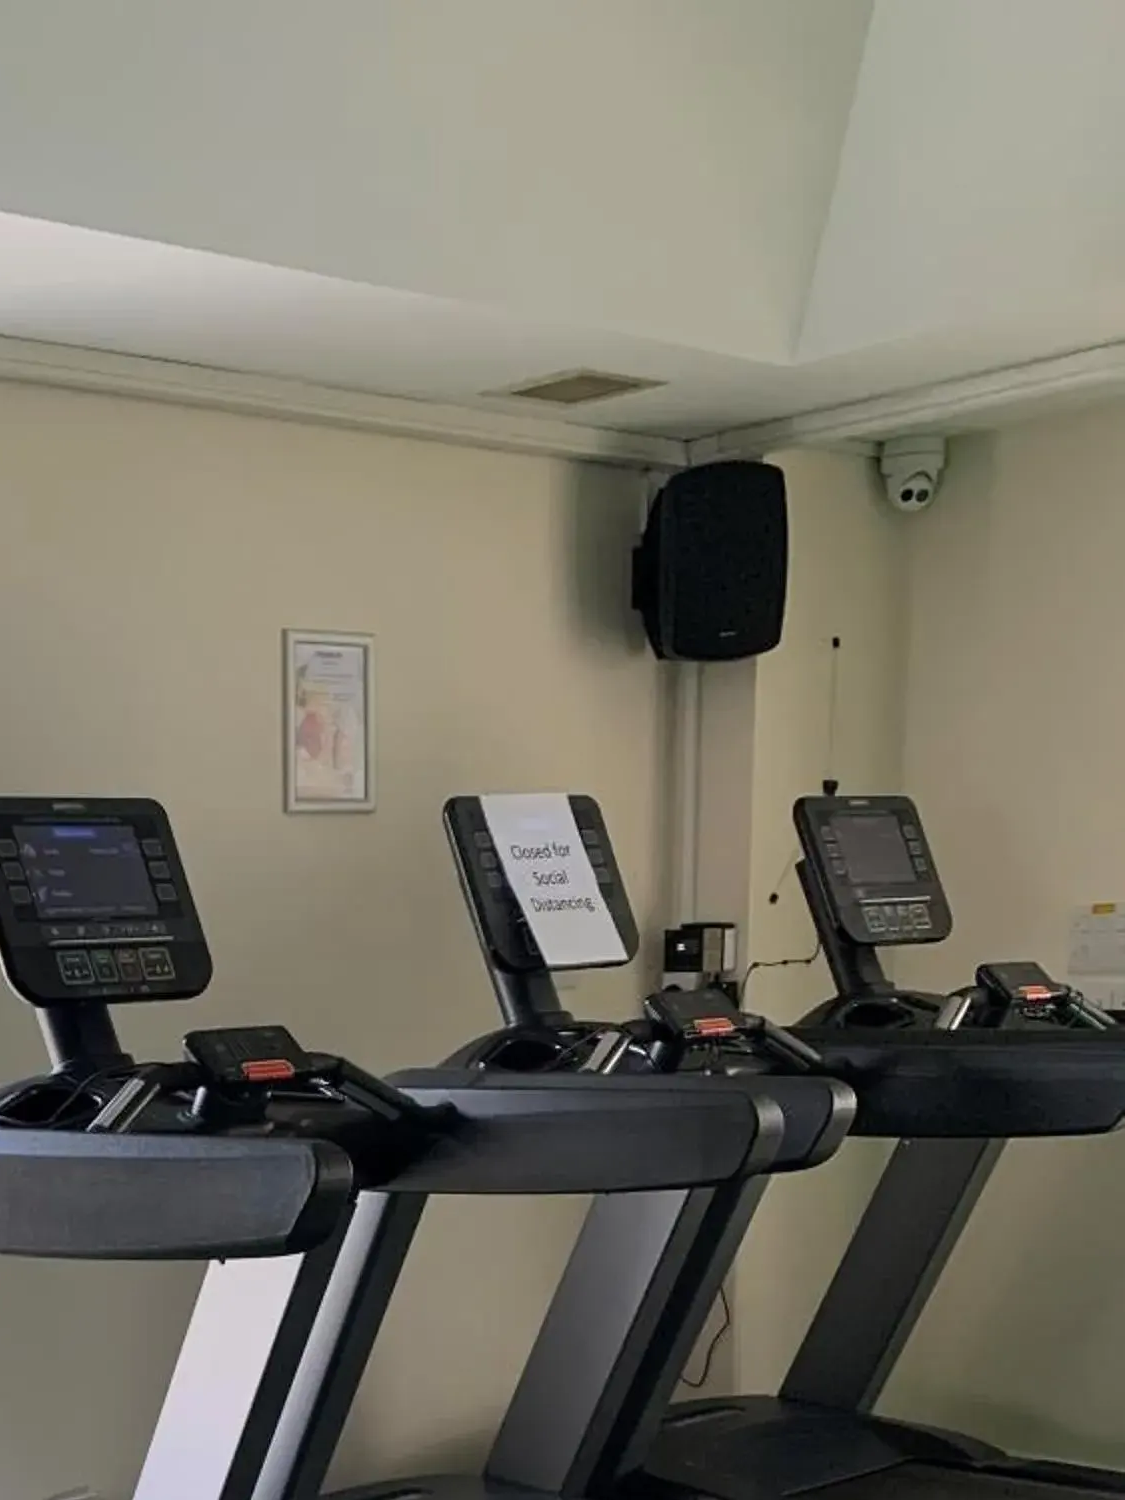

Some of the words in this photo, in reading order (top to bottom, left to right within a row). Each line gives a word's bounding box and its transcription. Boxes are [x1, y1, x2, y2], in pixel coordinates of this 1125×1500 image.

[510, 843, 552, 860] Closed
[551, 840, 571, 857] for
[532, 869, 570, 886] Social
